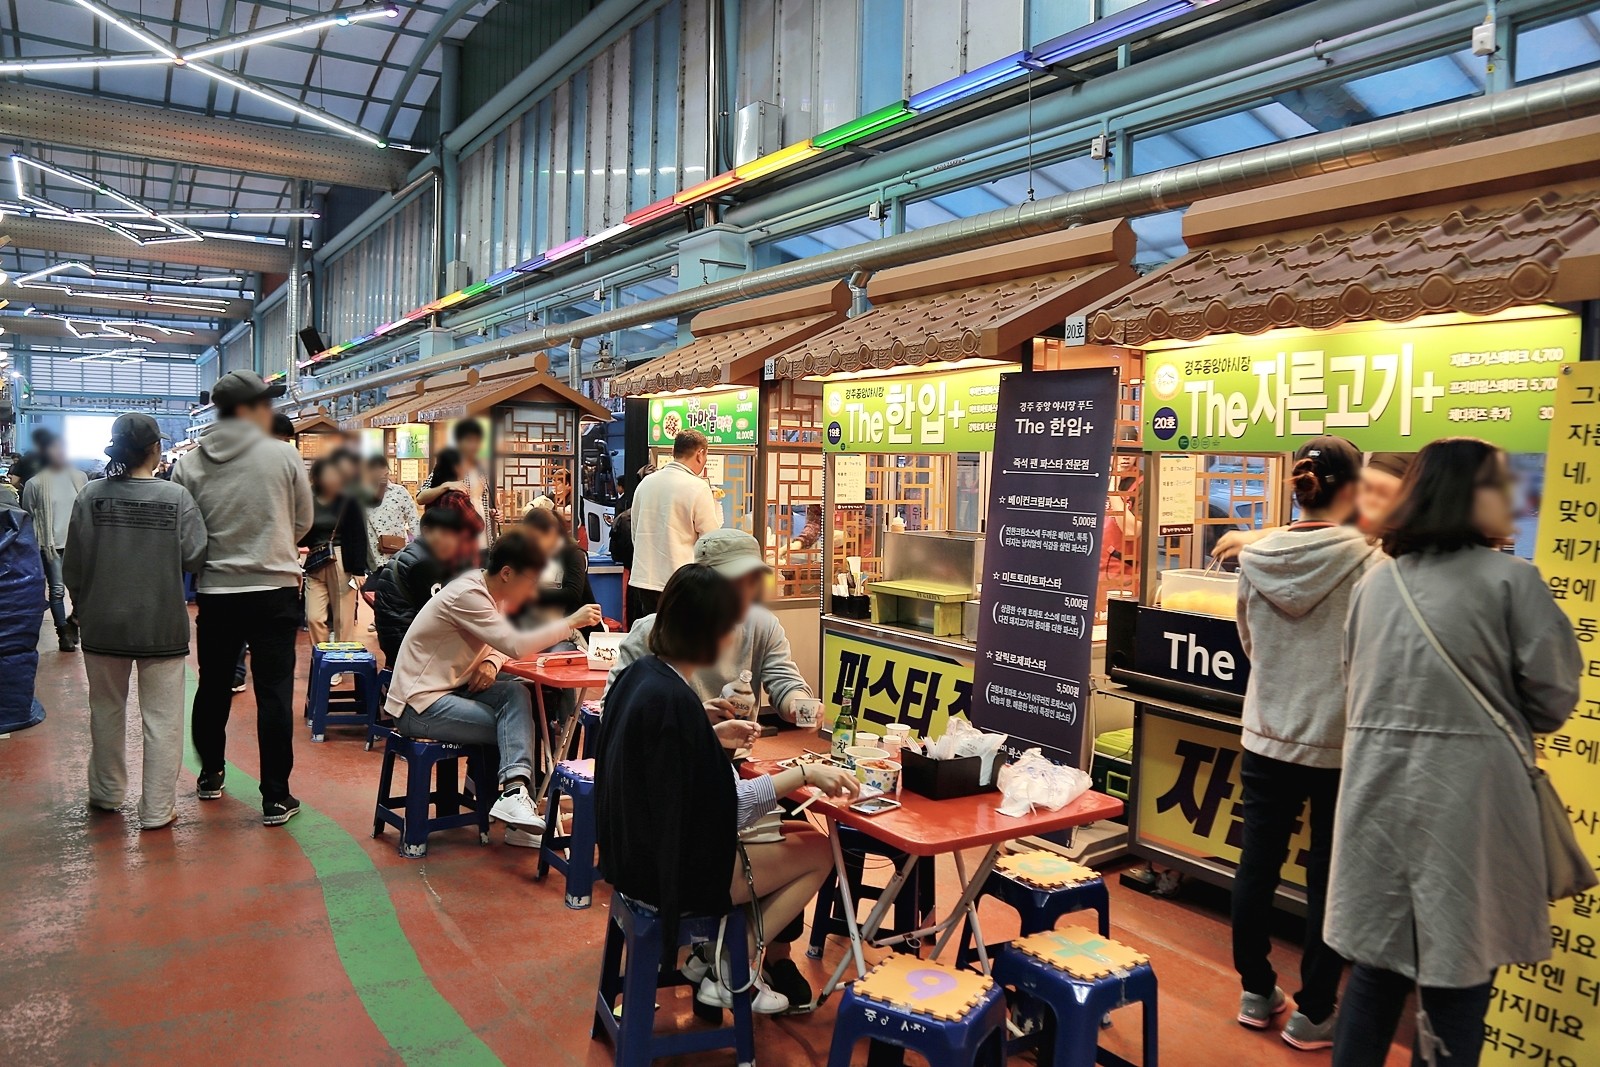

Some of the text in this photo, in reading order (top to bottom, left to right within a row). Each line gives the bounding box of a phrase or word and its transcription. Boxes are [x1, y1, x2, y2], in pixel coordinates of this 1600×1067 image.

[1066, 321, 1085, 339] 20호
[1449, 348, 1564, 367] 자른고기스테이크 4,700
[1185, 356, 1251, 375] 경주중앙야시장
[845, 386, 885, 400] 경주중앙야시장
[1449, 378, 1529, 394] 프리미엄스테이크
[1571, 386, 1600, 405] 그
[1020, 400, 1093, 412] 경주 중앙 야시장 푸드
[1539, 406, 1554, 420] 30
[1448, 406, 1511, 422] 체다치즈 추가
[1015, 417, 1094, 437] The 한입+
[1154, 416, 1177, 430] 20호
[828, 427, 841, 437] 19호
[1013, 457, 1090, 471] 즉석 팬 파스타 전문점
[1008, 495, 1069, 509] 베이컨크림파스타
[1072, 516, 1097, 528] 5,000원
[1071, 543, 1088, 554] 파스타
[1002, 571, 1062, 589] 미트토마토파스타
[1064, 596, 1088, 611] 5,000원
[1028, 608, 1043, 619] 토마토
[1044, 611, 1060, 622] 소스에
[998, 615, 1008, 625] 다진
[1063, 625, 1079, 637] 파스타
[995, 651, 1047, 671] 갈릭로제파스타
[1163, 631, 1236, 681] The
[832, 650, 943, 740] 파스타
[1004, 687, 1017, 698] 토마토
[1056, 682, 1080, 699] 5,500원
[1055, 711, 1071, 723] 파스타
[1008, 747, 1023, 759] 파스
